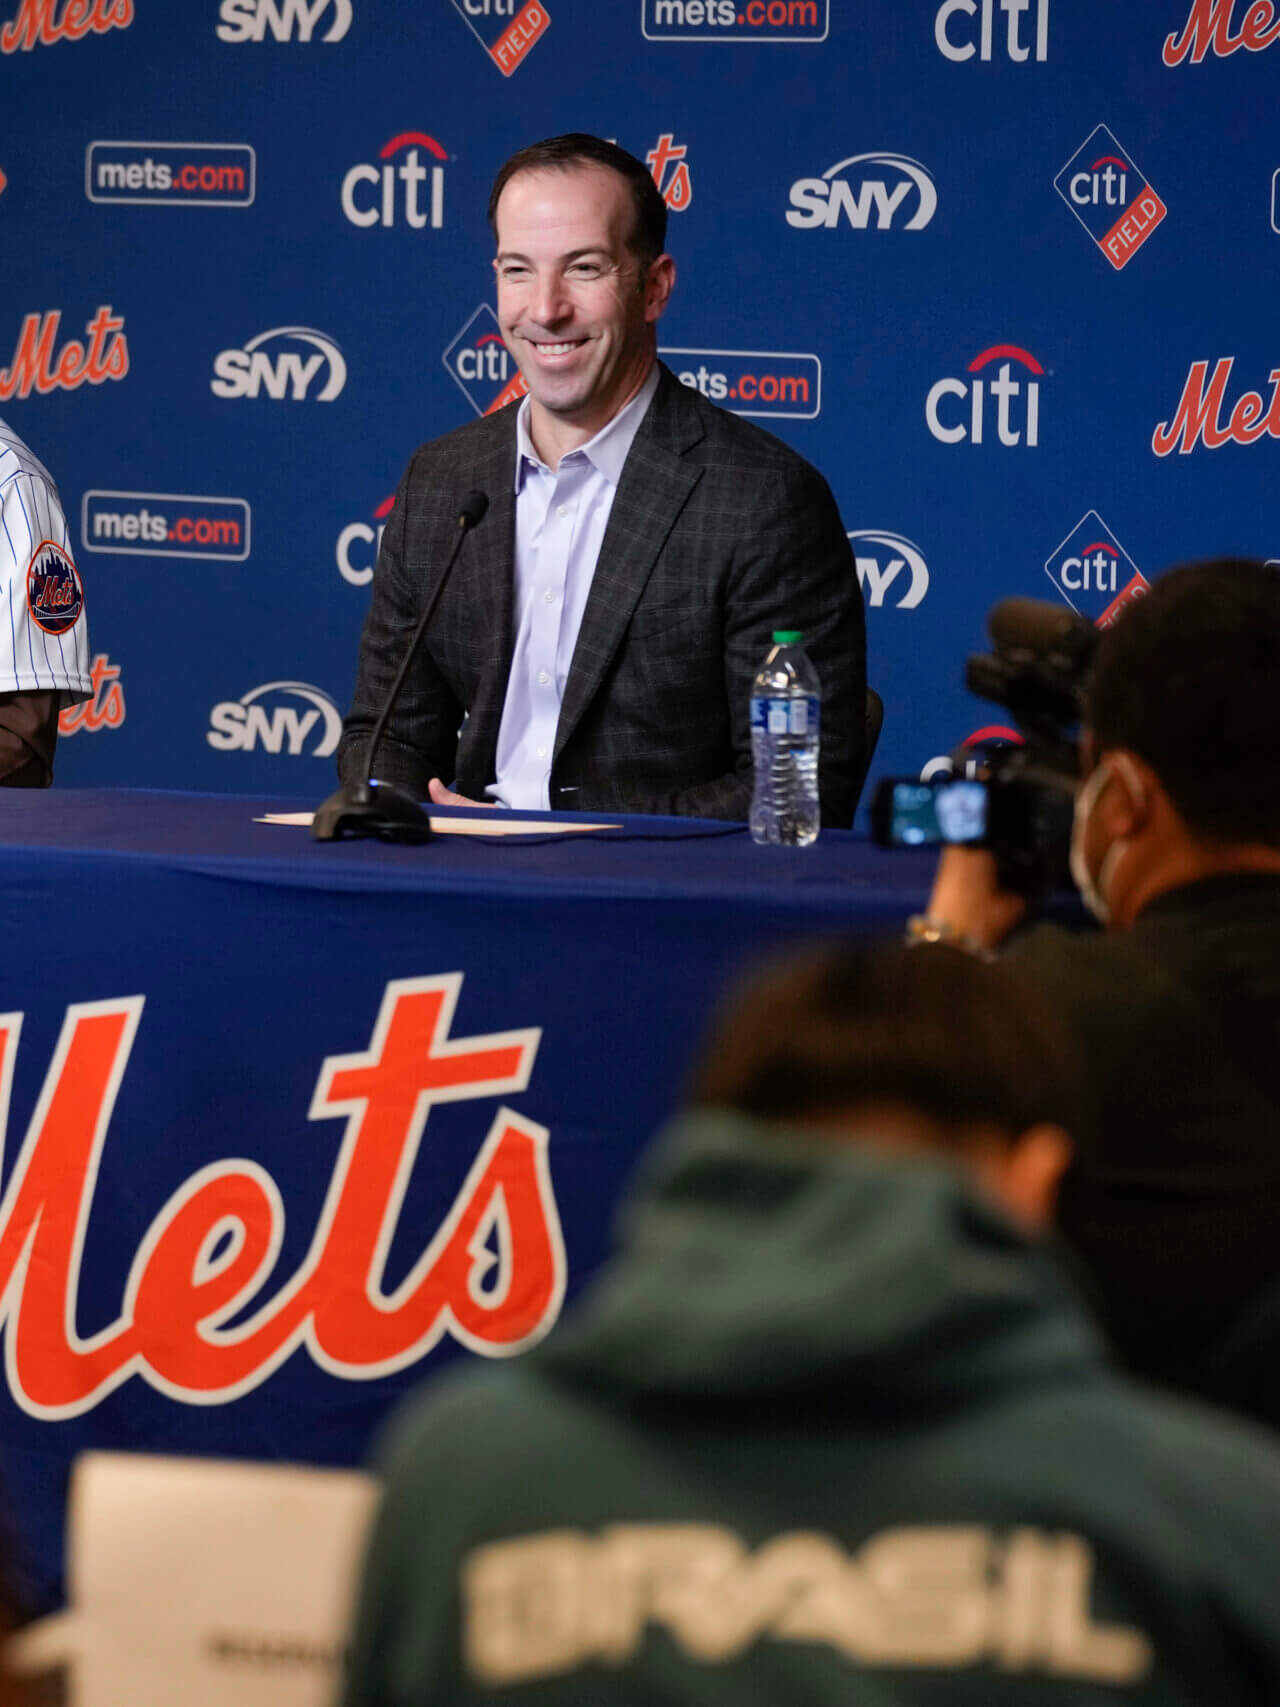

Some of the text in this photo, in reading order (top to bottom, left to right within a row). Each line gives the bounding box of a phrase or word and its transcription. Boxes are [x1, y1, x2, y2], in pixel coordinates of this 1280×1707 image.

[216, 0, 326, 42] SNY
[497, 7, 542, 66] FIELD
[655, 0, 817, 26] mets.com
[935, 0, 1049, 62] citi
[1162, 0, 1280, 66] Me
[98, 160, 245, 191] mets.com
[341, 149, 444, 229] citi
[646, 133, 692, 212] ts
[1070, 164, 1126, 205] citi
[786, 178, 913, 230] SNY
[1107, 198, 1158, 260] FIELD
[211, 349, 325, 402] SNY
[457, 342, 508, 381] citi
[679, 366, 810, 402] ets.com
[926, 363, 1040, 447] citi
[1151, 356, 1280, 457] Me
[93, 510, 241, 545] mets.com
[36, 576, 73, 607] Mets
[1061, 551, 1117, 591] citi
[57, 654, 126, 737] ets
[207, 702, 322, 756] SNY
[462, 1520, 1150, 1687] BRASIL
